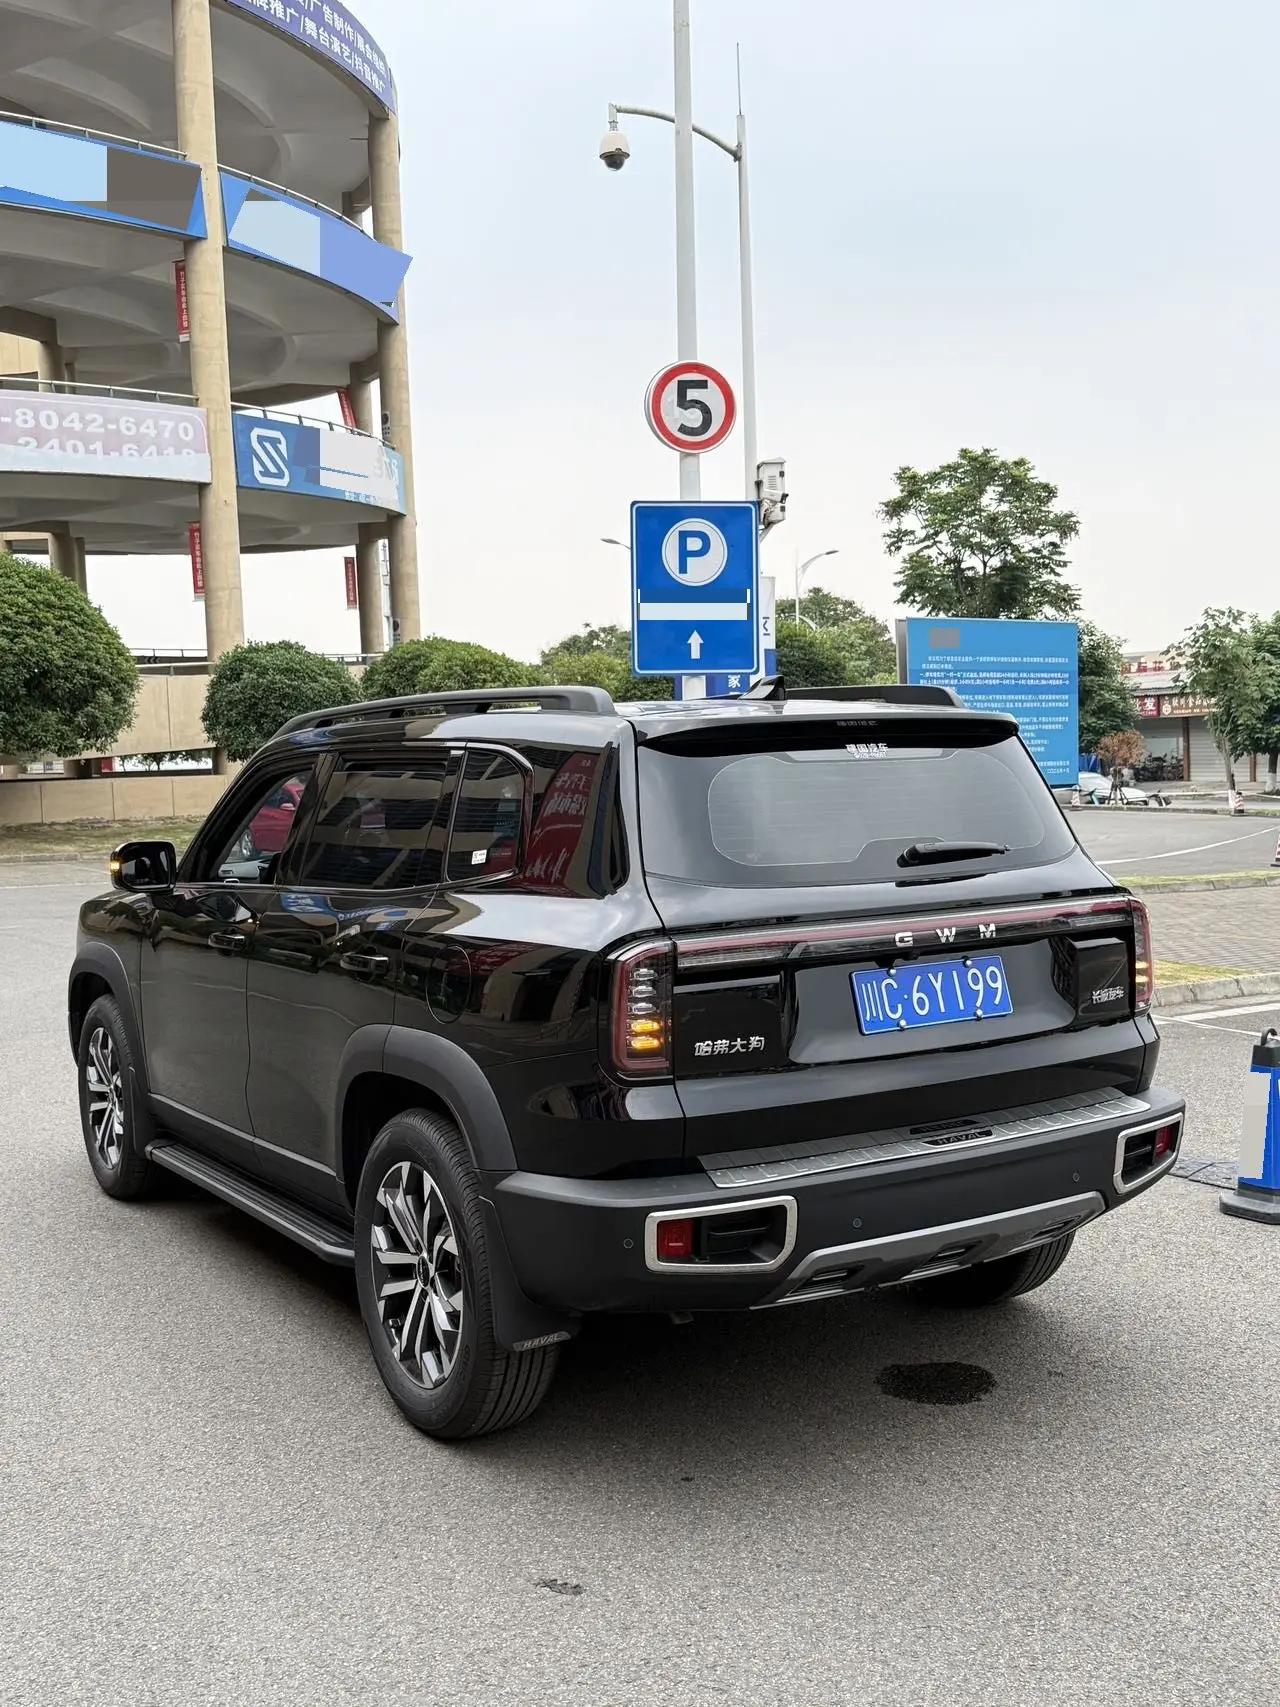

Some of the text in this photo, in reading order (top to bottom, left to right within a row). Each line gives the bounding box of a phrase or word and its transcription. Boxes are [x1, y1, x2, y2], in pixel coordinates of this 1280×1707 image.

[676, 378, 713, 437] 5
[678, 530, 711, 574] P
[894, 924, 997, 947] GWM
[694, 1035, 765, 1056] 哈弗大狗
[937, 1131, 986, 1145] HAVAL
[522, 1332, 562, 1350] HAVAL
